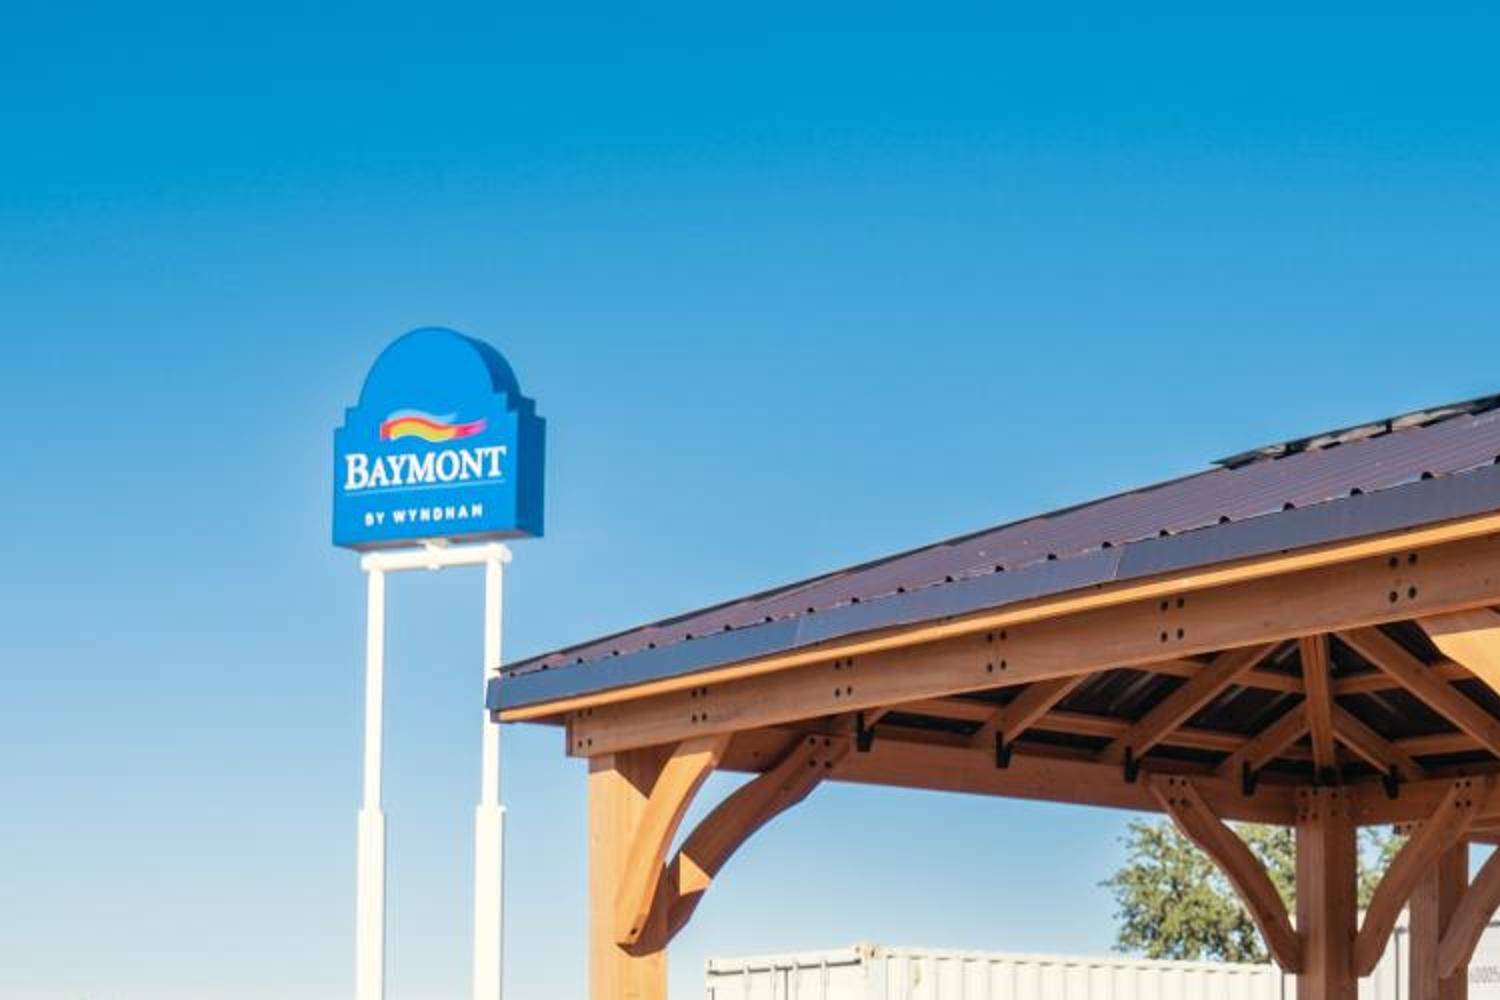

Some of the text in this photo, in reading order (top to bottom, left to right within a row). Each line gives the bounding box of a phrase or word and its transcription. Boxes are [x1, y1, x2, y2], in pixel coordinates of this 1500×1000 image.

[344, 446, 507, 490] BAYMONT
[364, 504, 483, 527] BY WYNDHAM
